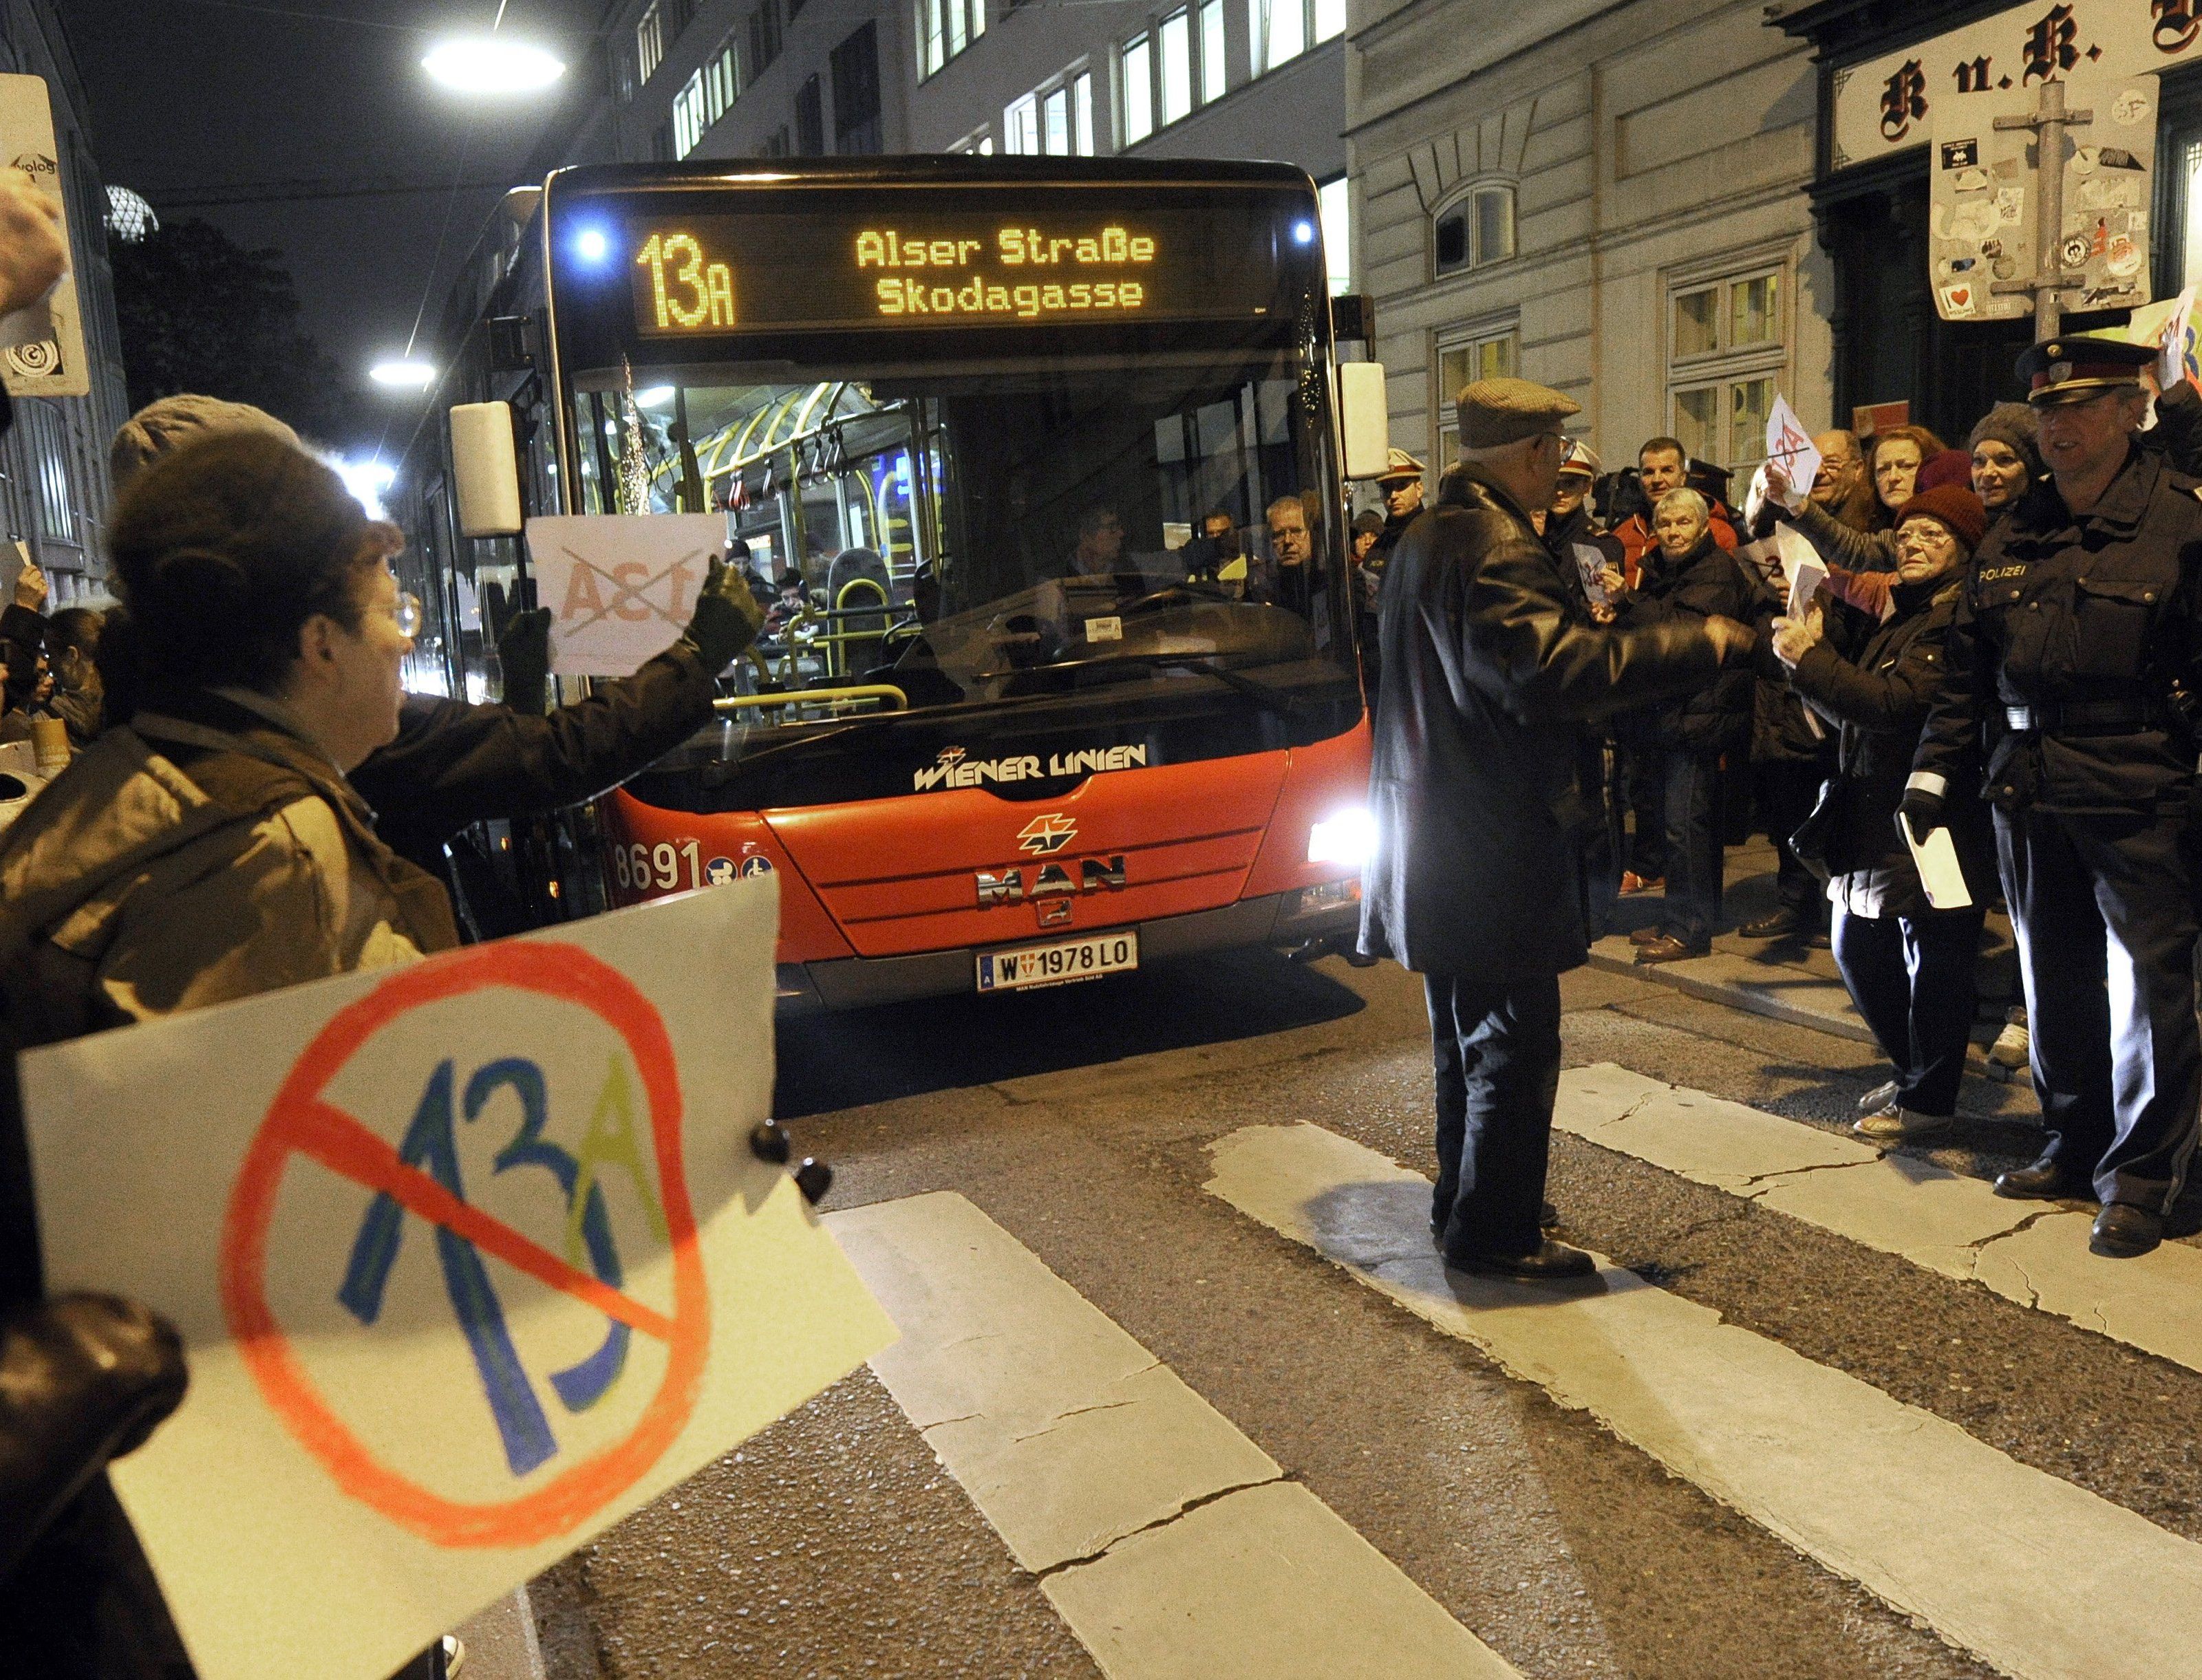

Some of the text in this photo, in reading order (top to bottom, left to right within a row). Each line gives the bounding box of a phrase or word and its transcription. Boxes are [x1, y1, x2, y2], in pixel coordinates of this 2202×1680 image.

[857, 227, 1155, 267] Alser Straße
[637, 235, 734, 327] 13A
[877, 277, 1143, 316] Skodagasse
[1978, 565, 2027, 583] POLIZEI
[914, 744, 1147, 791] WIENER LINIEN
[615, 841, 701, 890] 8691
[976, 855, 1127, 909] MAN
[1001, 957, 1018, 982] W
[1037, 945, 1094, 976] 1978
[338, 1051, 672, 1478] 13A
